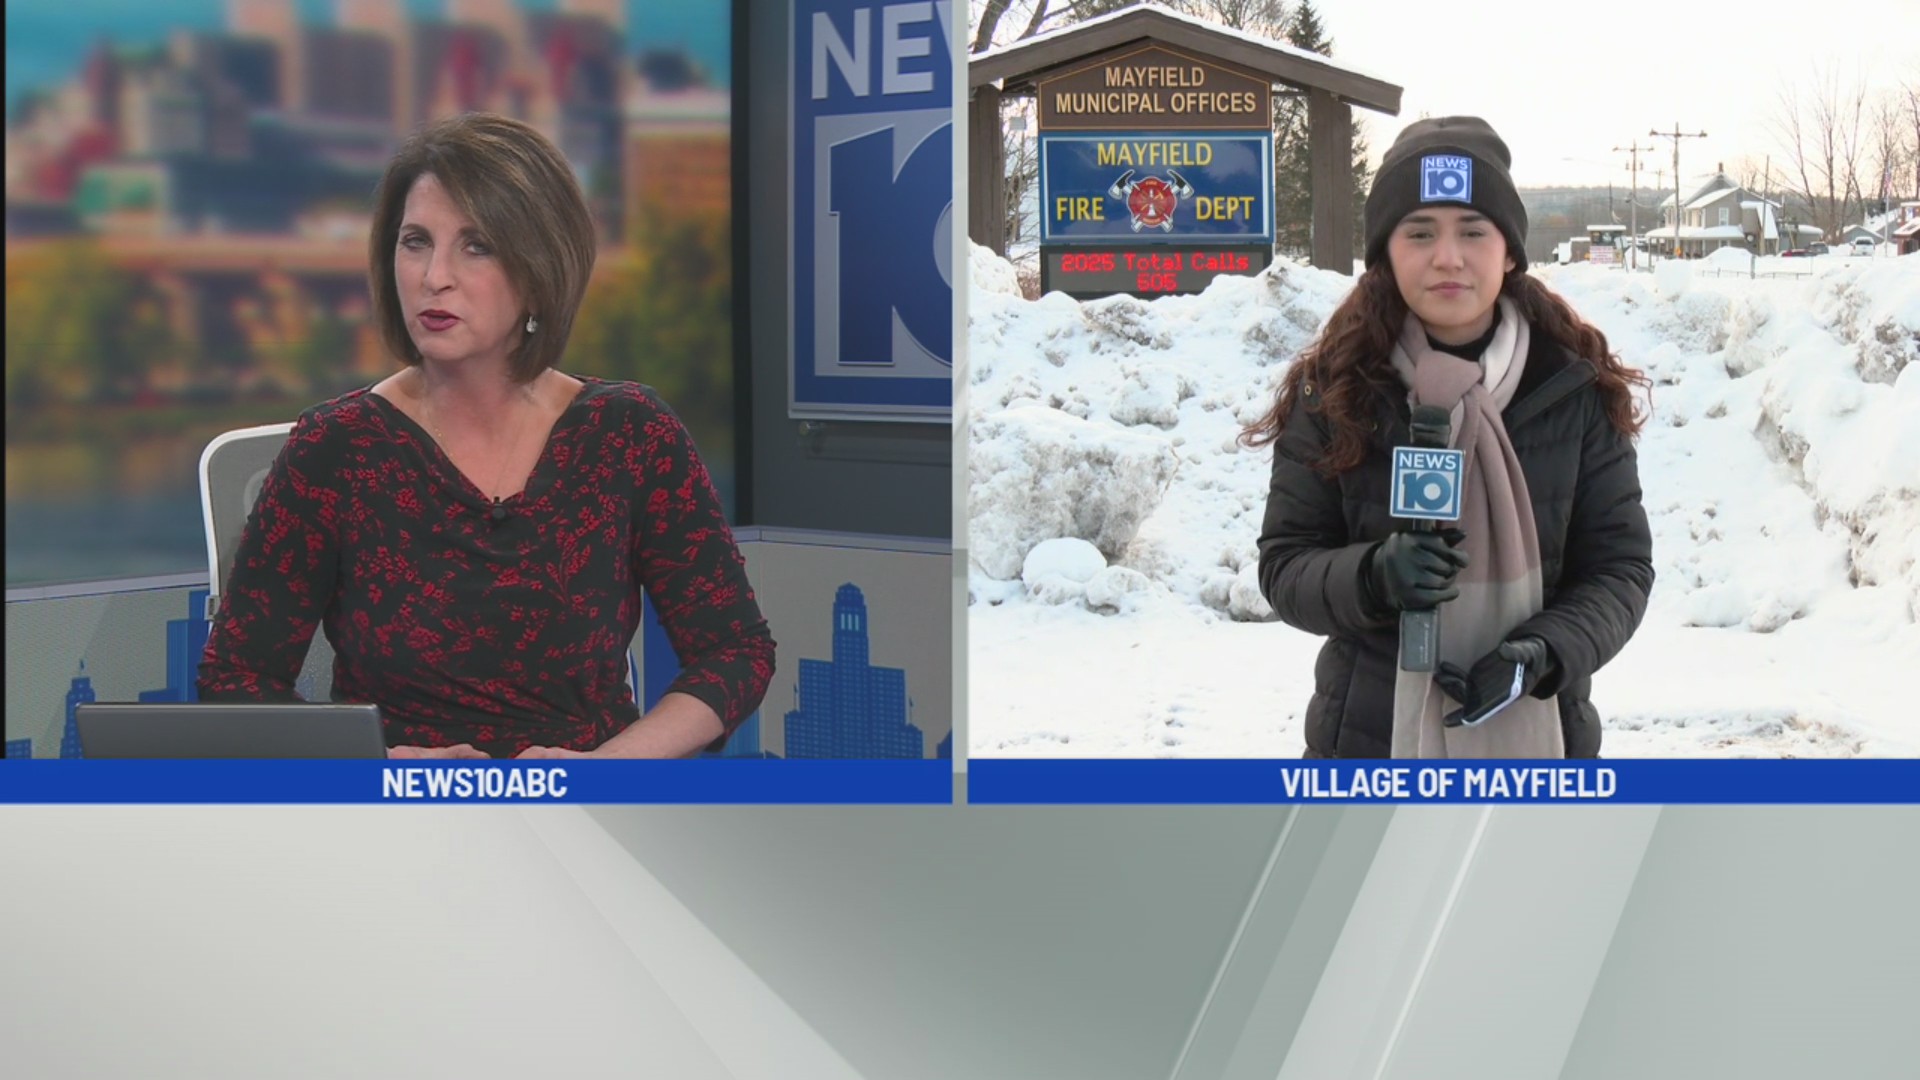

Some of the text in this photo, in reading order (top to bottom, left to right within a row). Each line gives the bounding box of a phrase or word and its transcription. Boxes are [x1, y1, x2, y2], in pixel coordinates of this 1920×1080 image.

[1105, 67, 1205, 87] MAYFIELD
[1056, 92, 1256, 113] MUNICIPAL OFFICES
[1097, 142, 1213, 166] MAYFIELD
[1426, 157, 1468, 170] NEWS
[1427, 169, 1465, 196] 10
[1056, 196, 1254, 221] FIRE DEPT
[1061, 252, 1249, 272] 2025 Total Calls
[1399, 452, 1457, 470] NEWS
[1402, 471, 1452, 511] 10
